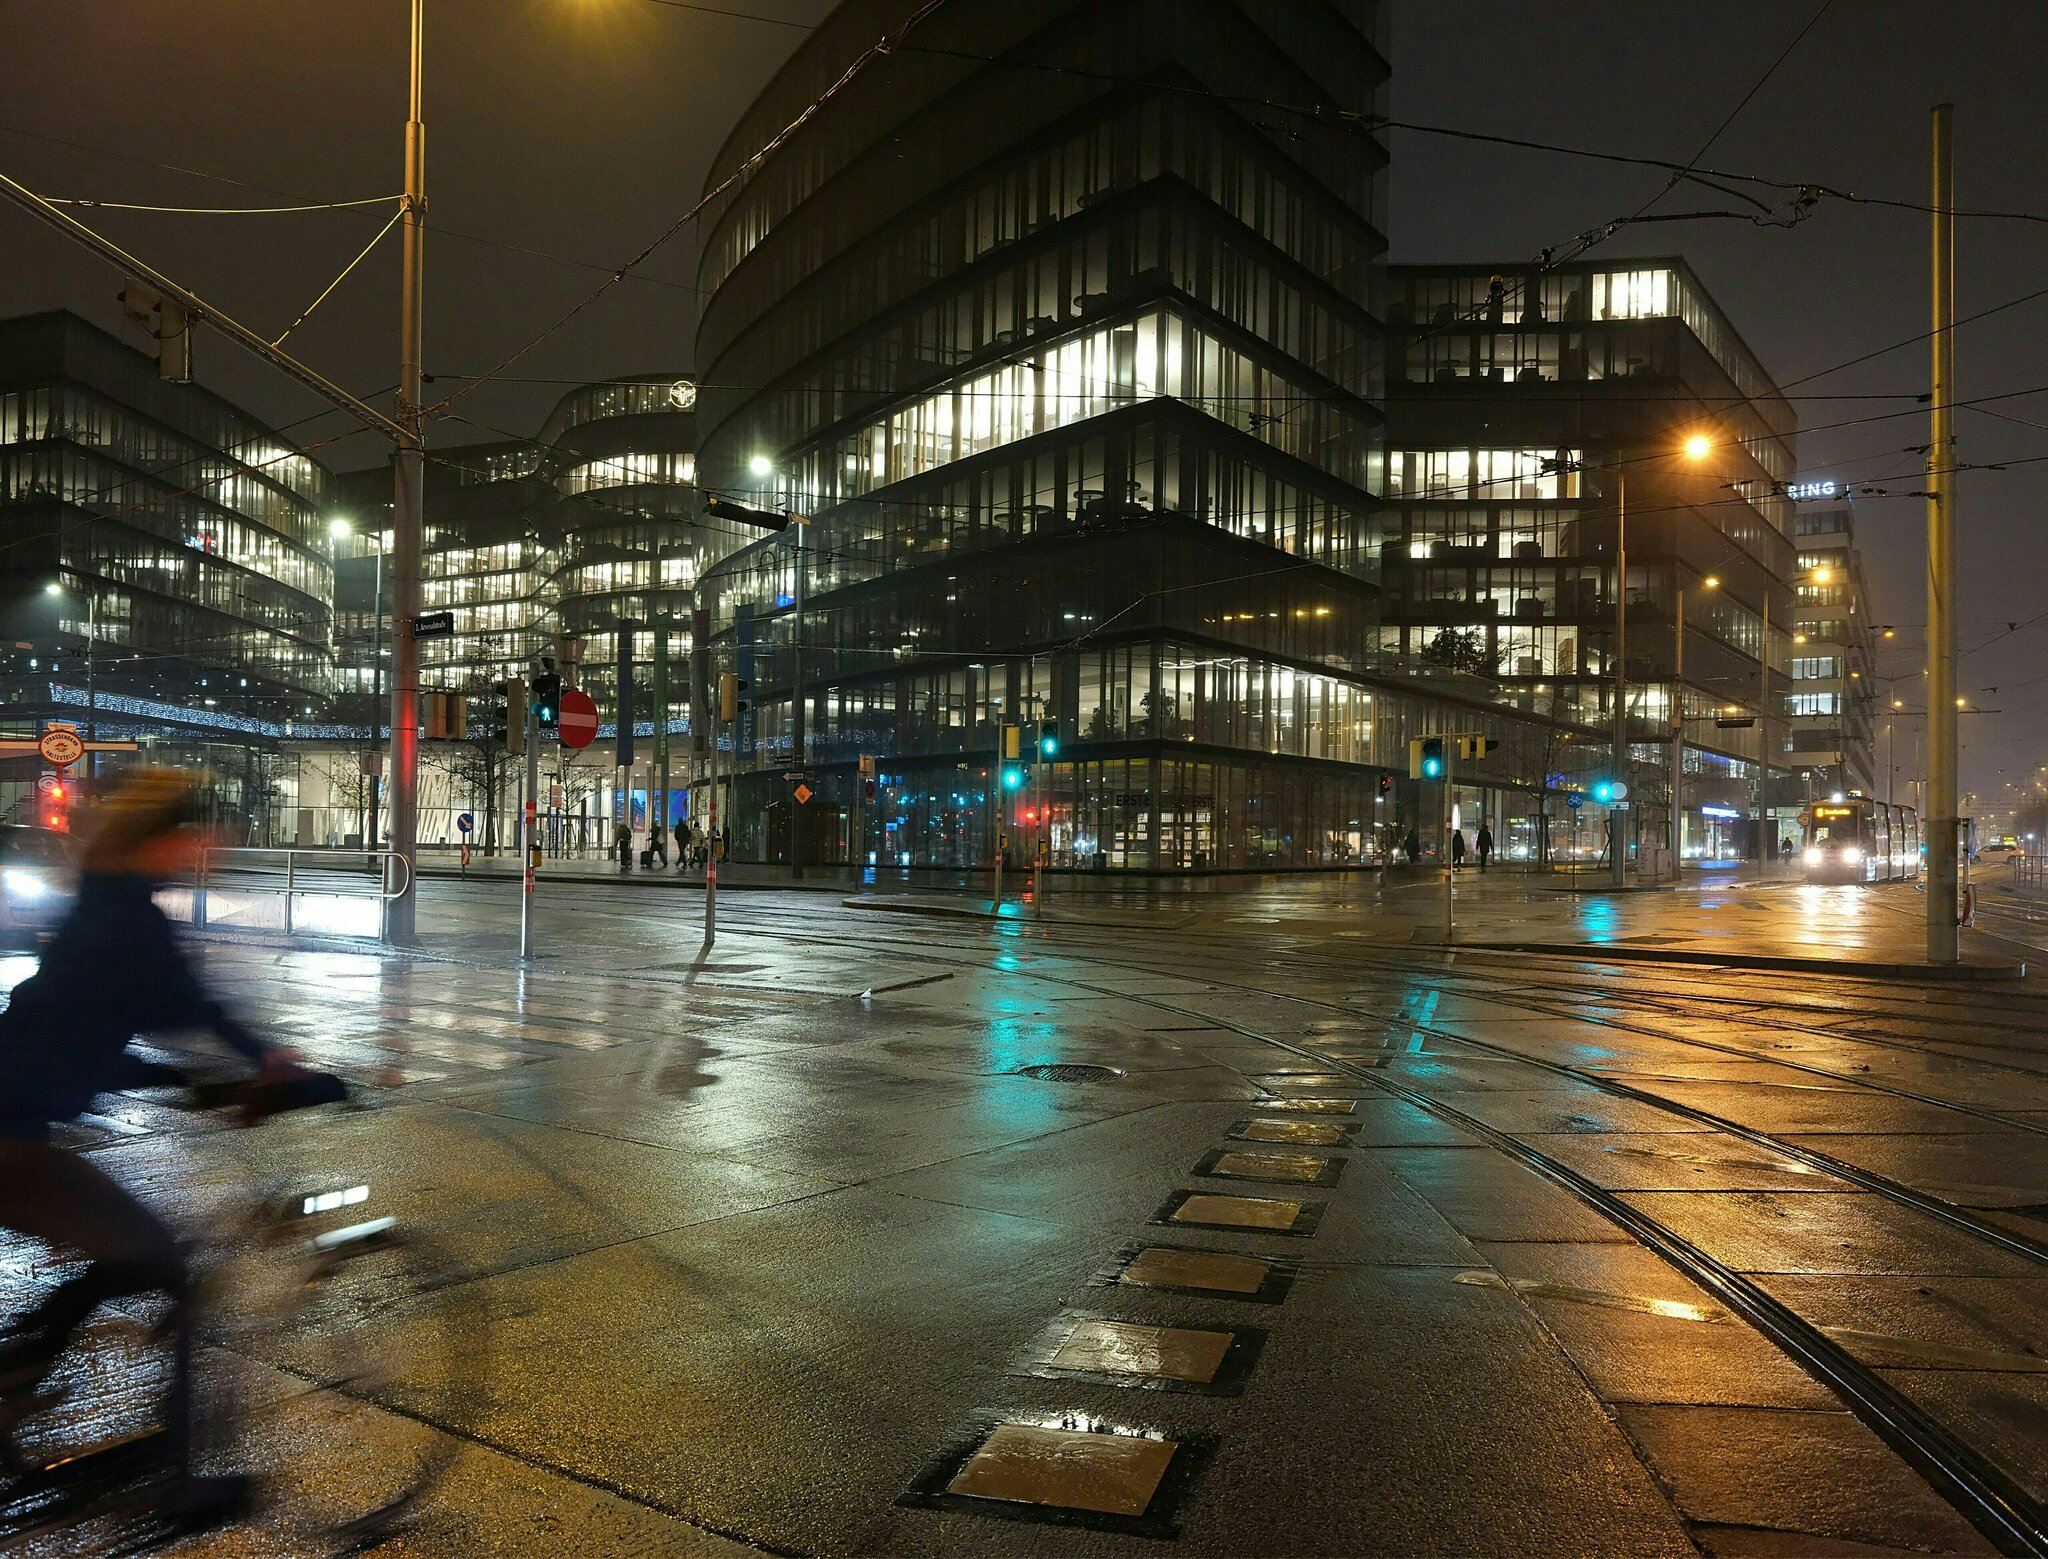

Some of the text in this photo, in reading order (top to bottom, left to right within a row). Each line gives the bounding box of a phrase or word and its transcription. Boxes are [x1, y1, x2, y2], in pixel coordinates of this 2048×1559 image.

[742, 713, 753, 752] ERSTE
[44, 733, 79, 746] STRASSENBAHN
[45, 749, 78, 761] HALTESTELLE
[1116, 794, 1151, 807] ERSTE
